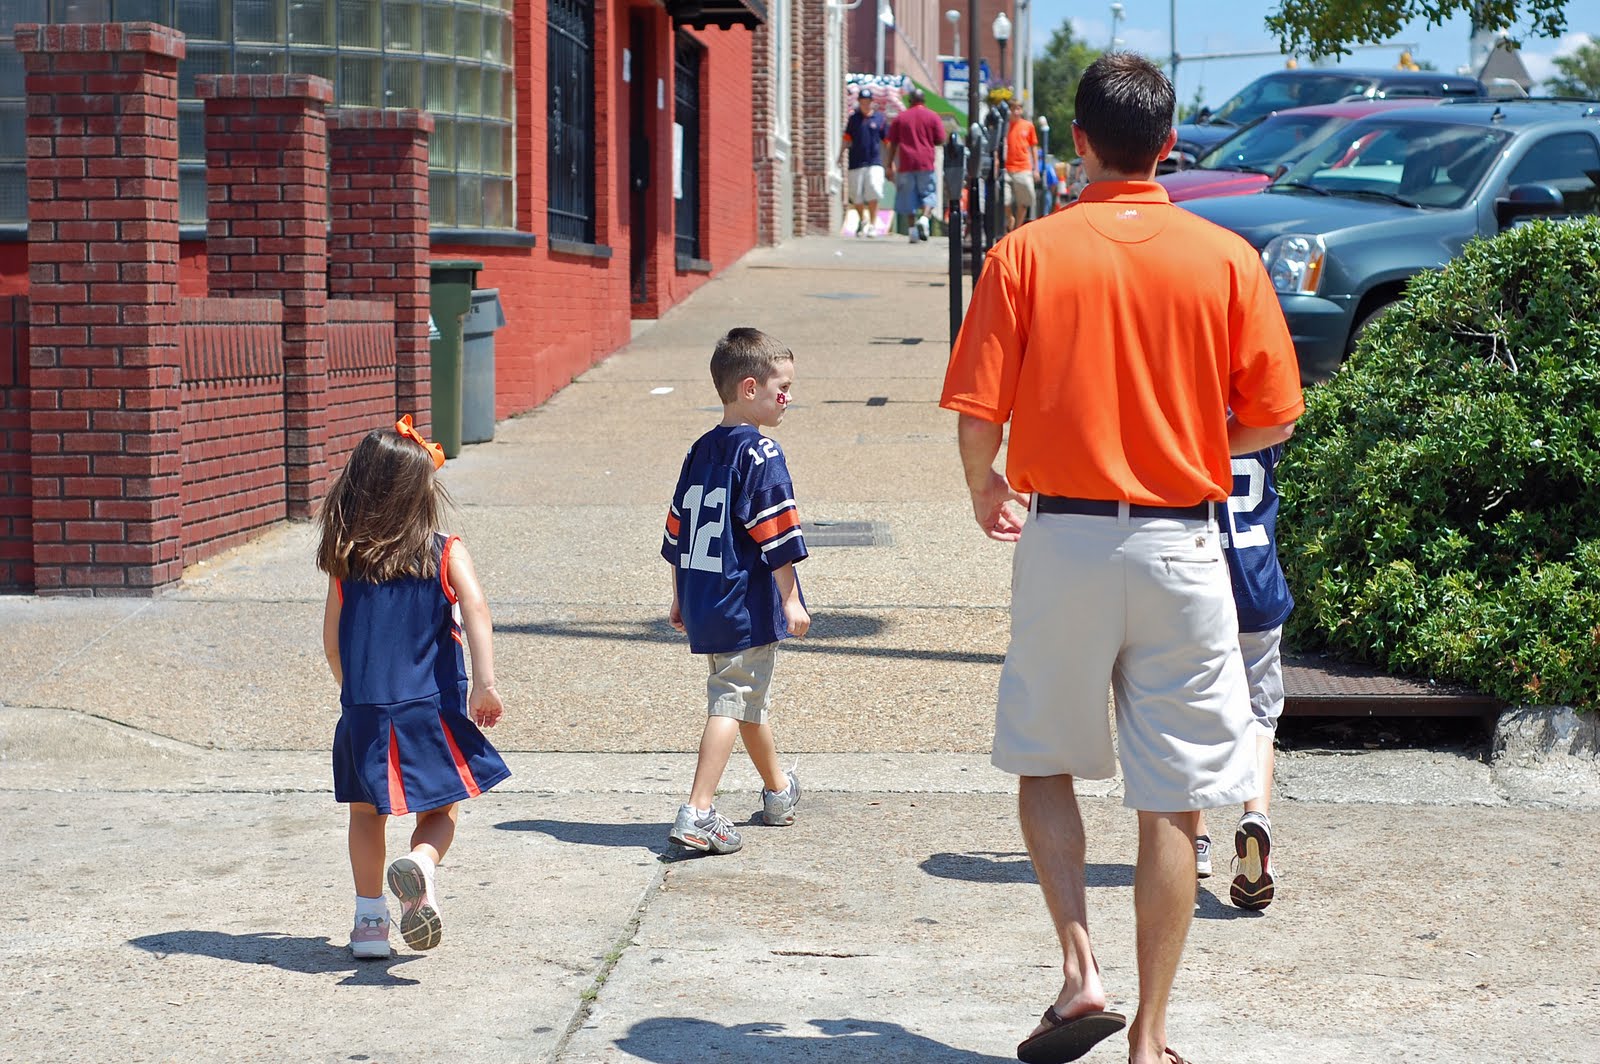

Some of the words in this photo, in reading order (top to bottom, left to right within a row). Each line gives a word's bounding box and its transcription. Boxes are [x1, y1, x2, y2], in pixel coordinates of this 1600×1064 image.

[748, 437, 779, 465] 12
[682, 485, 726, 573] 12
[1220, 458, 1270, 549] 2
